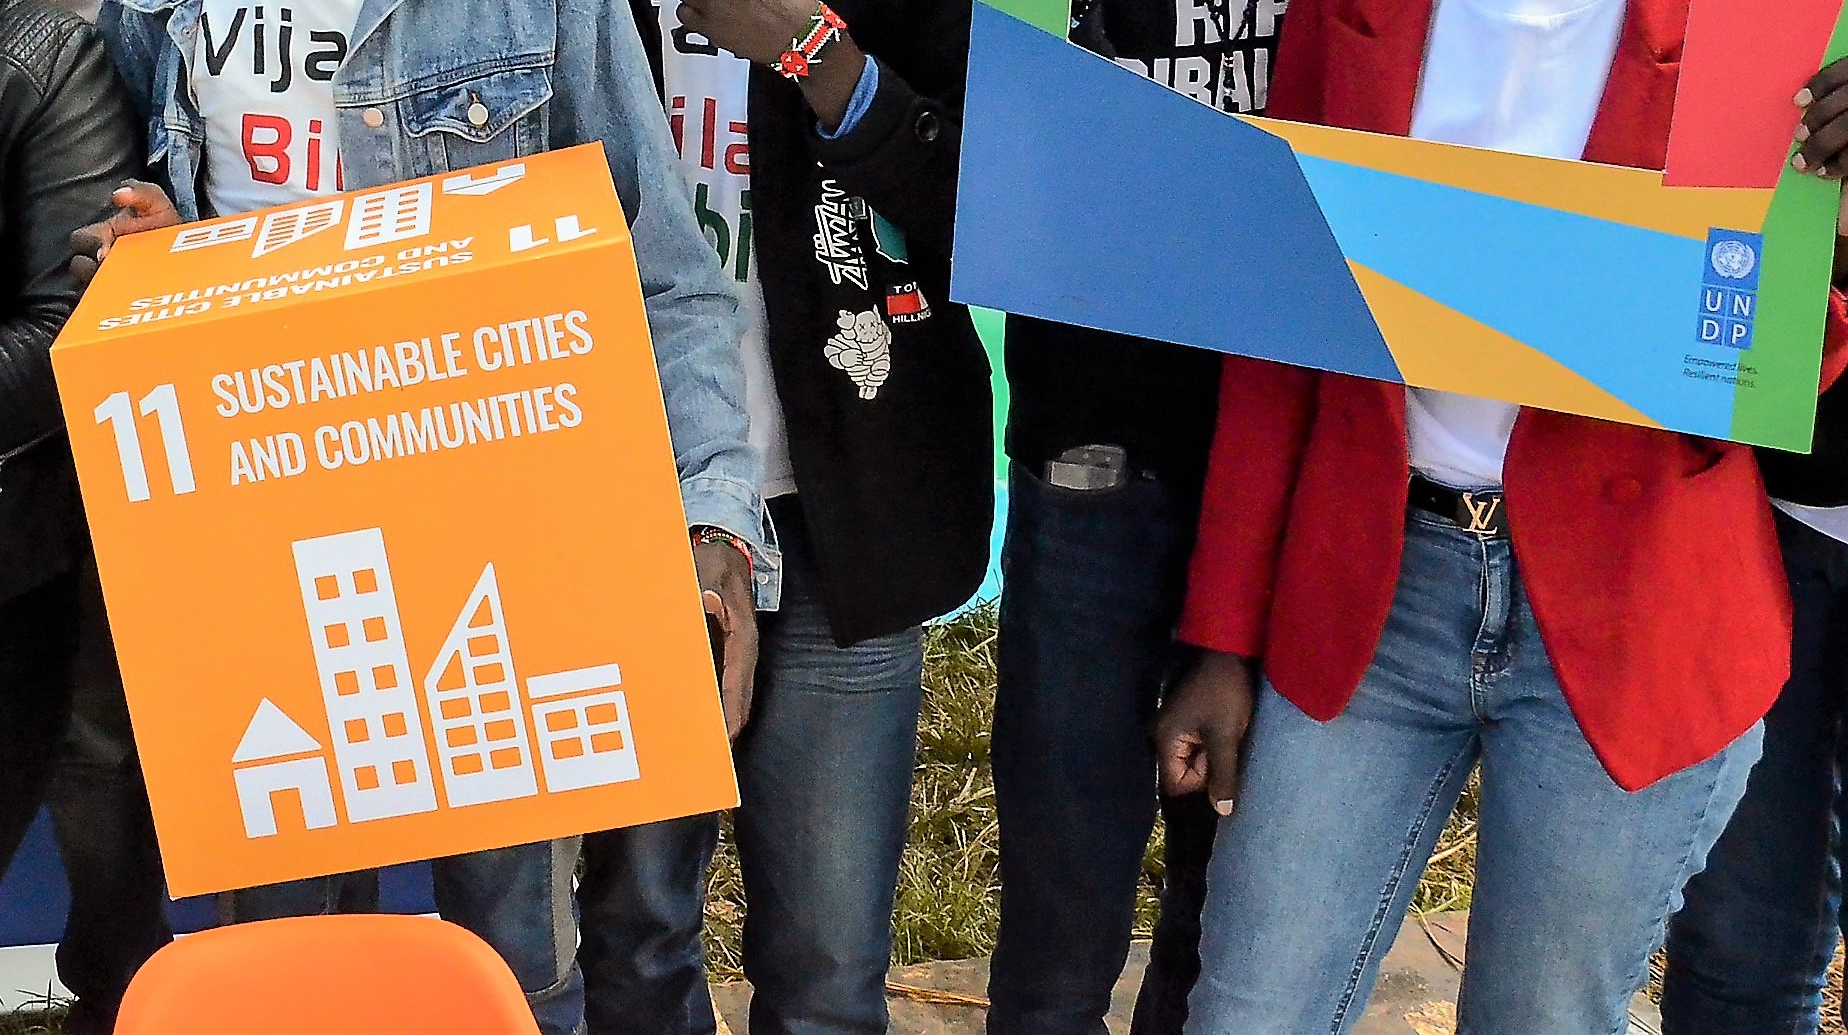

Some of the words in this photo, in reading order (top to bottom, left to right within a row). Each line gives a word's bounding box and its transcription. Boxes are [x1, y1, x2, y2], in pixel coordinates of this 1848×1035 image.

[396, 236, 474, 261] AND
[129, 254, 387, 312] COMMUNITIES
[222, 250, 474, 309] SUSTAINABLE
[98, 301, 210, 331] CITIES
[210, 331, 469, 419] SUSTAINABLE
[472, 308, 594, 370] CITIES
[94, 383, 197, 503] 11
[229, 430, 308, 486] AND
[317, 381, 584, 474] COMMUNITIES
